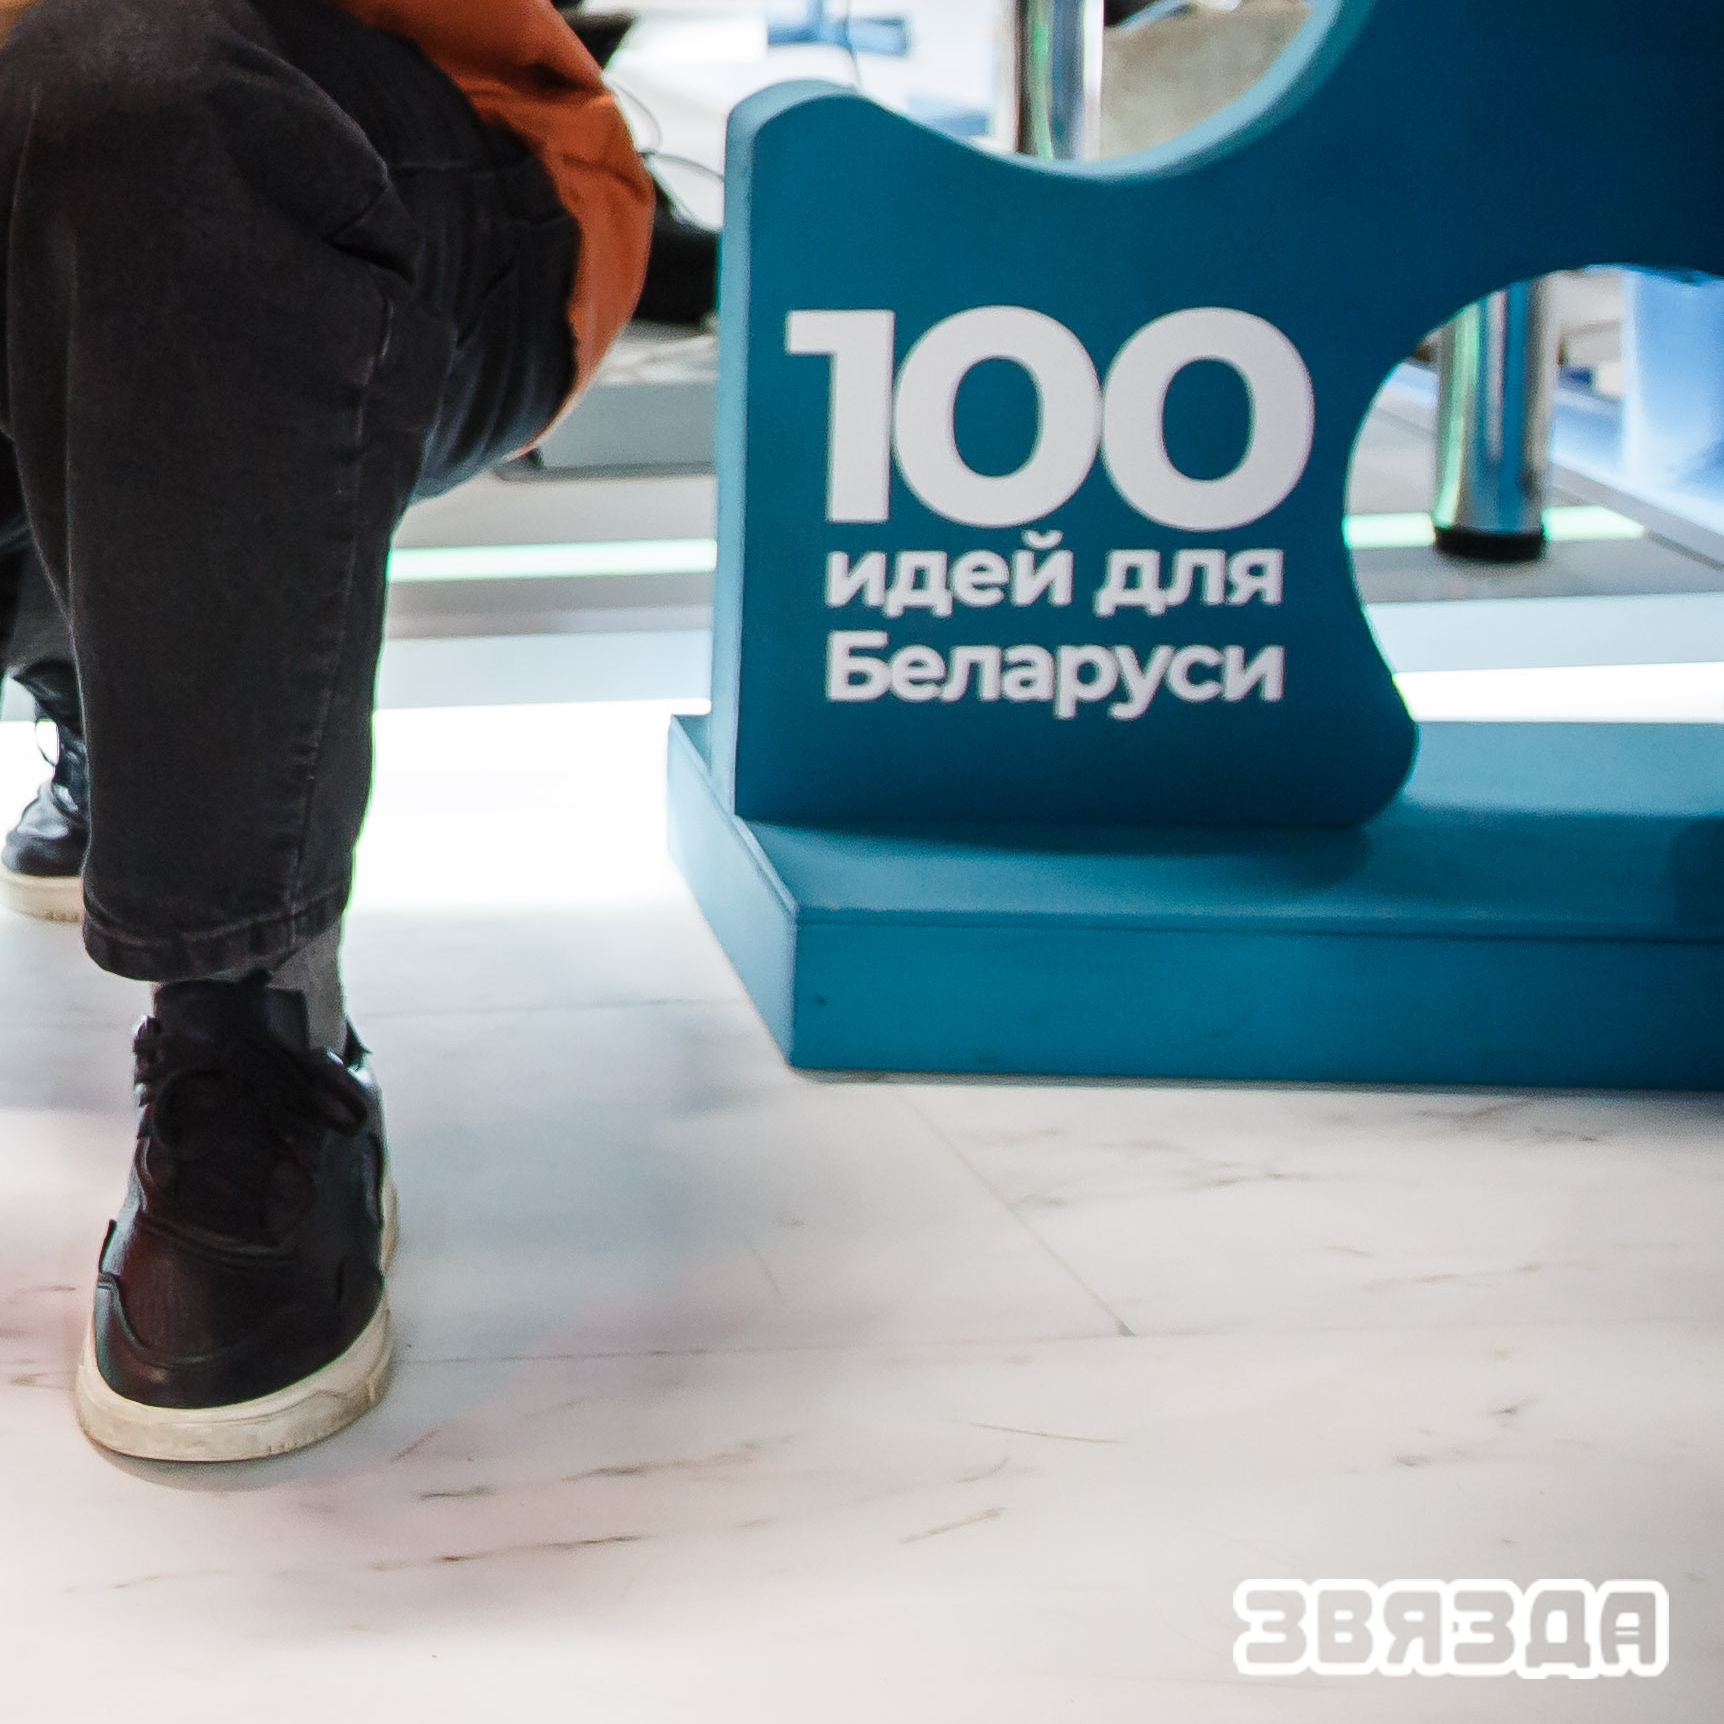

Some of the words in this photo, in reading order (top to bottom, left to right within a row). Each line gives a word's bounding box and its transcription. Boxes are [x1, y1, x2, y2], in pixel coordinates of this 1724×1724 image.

[785, 305, 1314, 531] 100
[825, 530, 1074, 618] идей
[1095, 548, 1283, 617] для
[825, 630, 1284, 720] Беларуси
